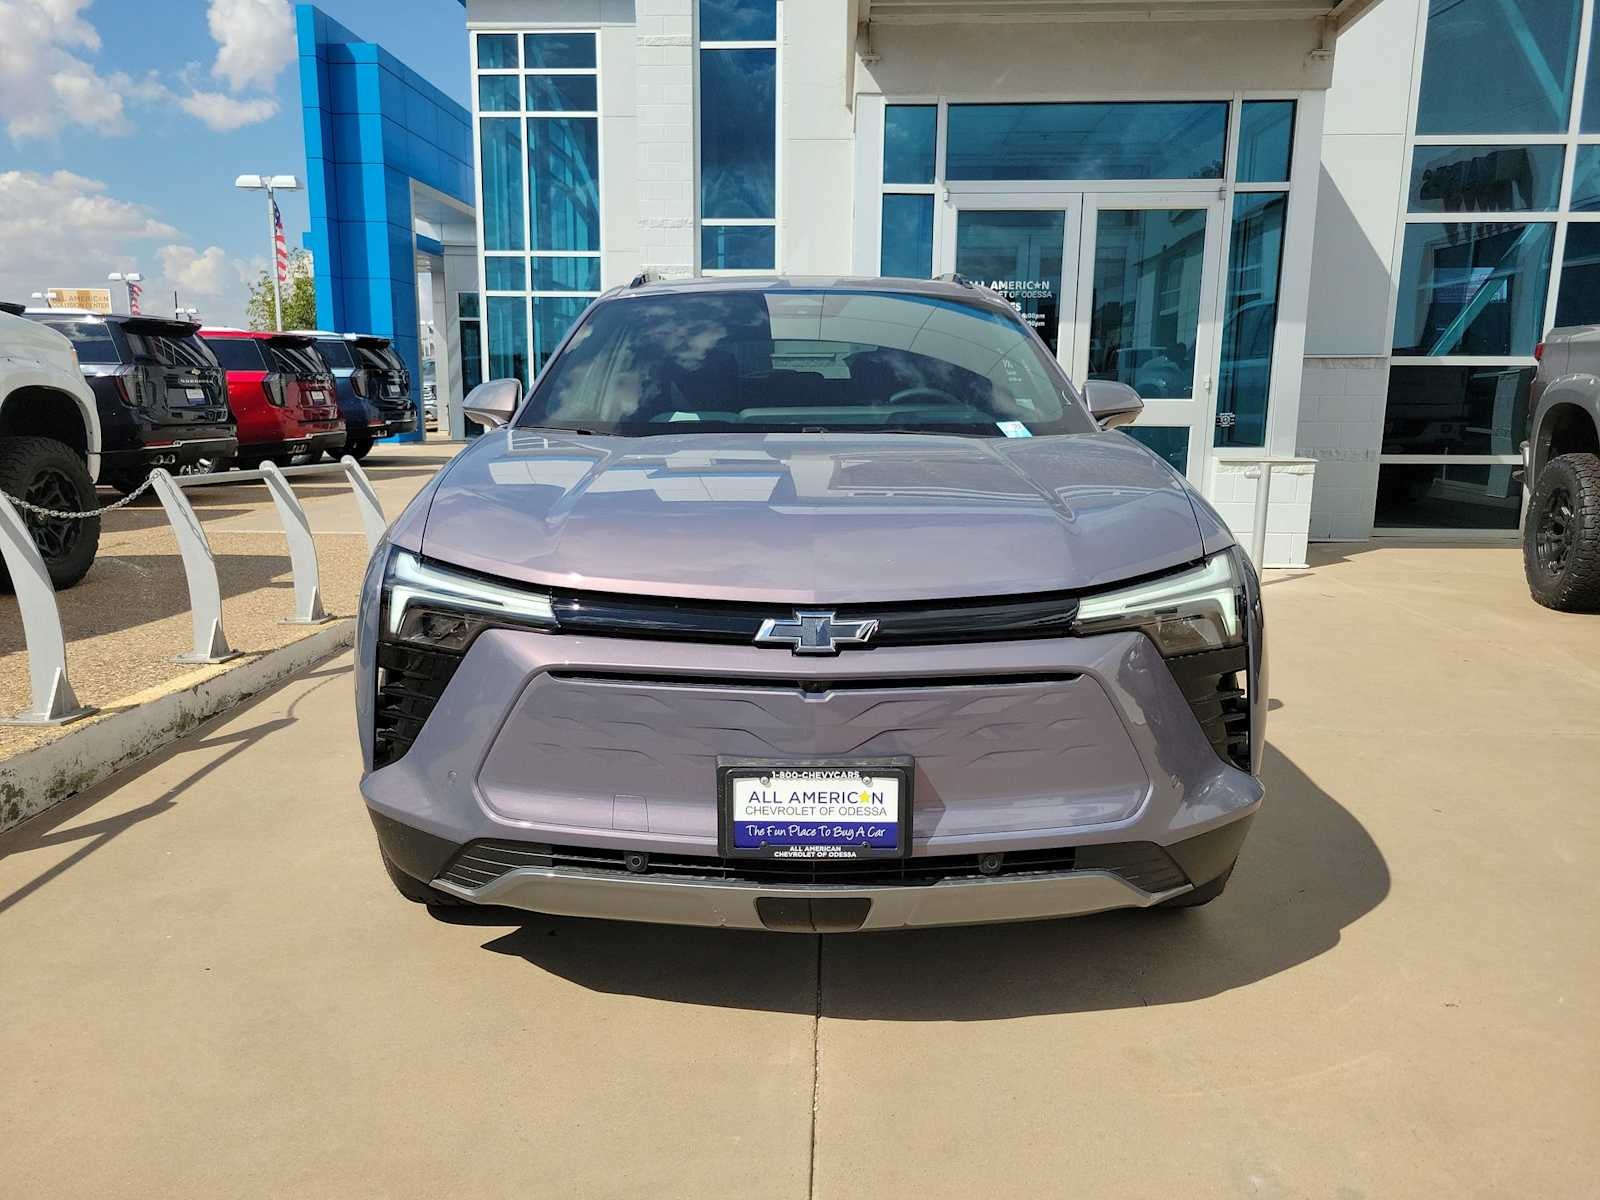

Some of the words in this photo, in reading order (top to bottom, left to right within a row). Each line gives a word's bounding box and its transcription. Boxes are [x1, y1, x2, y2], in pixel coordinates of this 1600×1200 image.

[1021, 290, 1052, 298] ODESSA
[772, 771, 860, 779] 1-800-CHEVYCARS
[748, 791, 782, 804] ALL
[745, 806, 816, 816] CHEVROLET
[819, 806, 834, 816] OF
[839, 806, 887, 816] ODESSA
[746, 825, 765, 836] The
[767, 825, 786, 836] Fun
[789, 825, 816, 837] Place
[819, 825, 831, 836] To
[833, 827, 855, 840] Buy
[855, 826, 865, 837] A
[867, 826, 886, 837] Car
